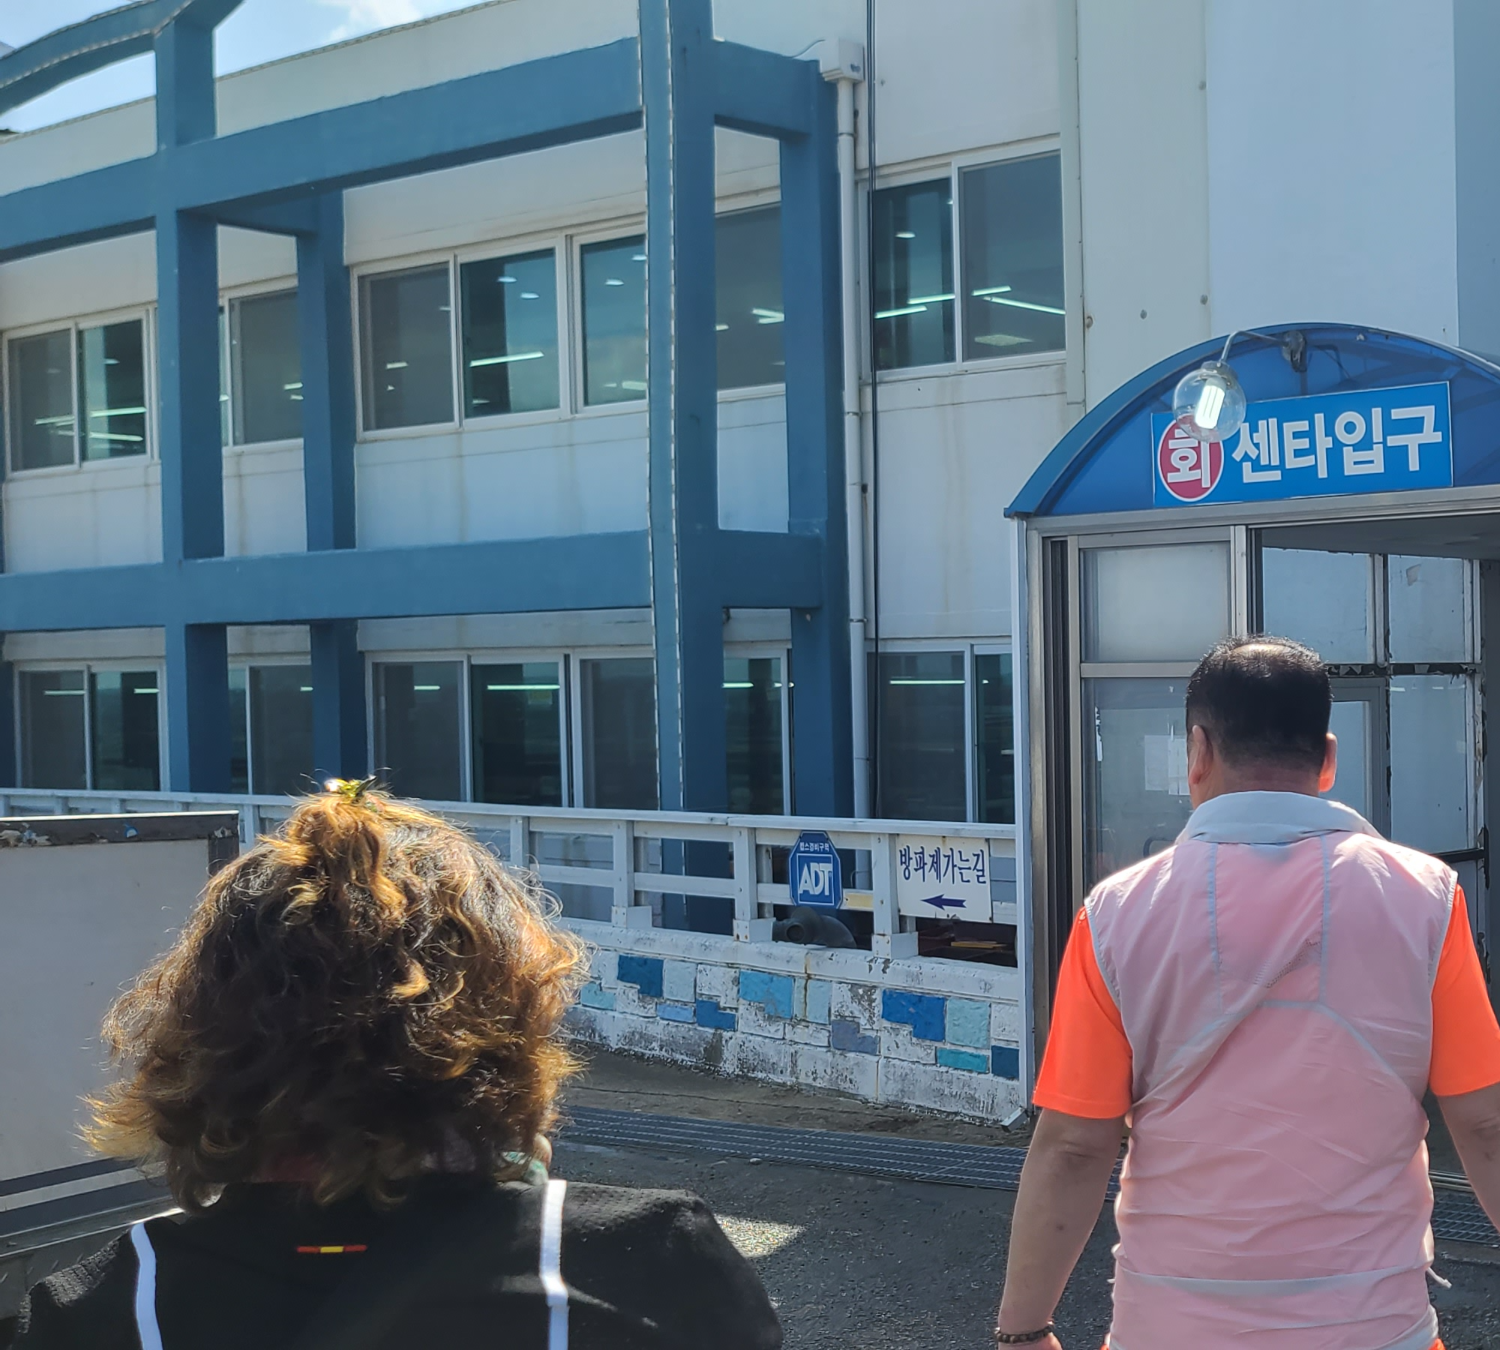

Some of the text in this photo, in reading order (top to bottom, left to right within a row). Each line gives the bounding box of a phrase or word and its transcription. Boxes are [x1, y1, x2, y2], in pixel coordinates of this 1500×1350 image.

[1167, 405, 1442, 488] 회 센타입구
[799, 862, 833, 896] ADT
